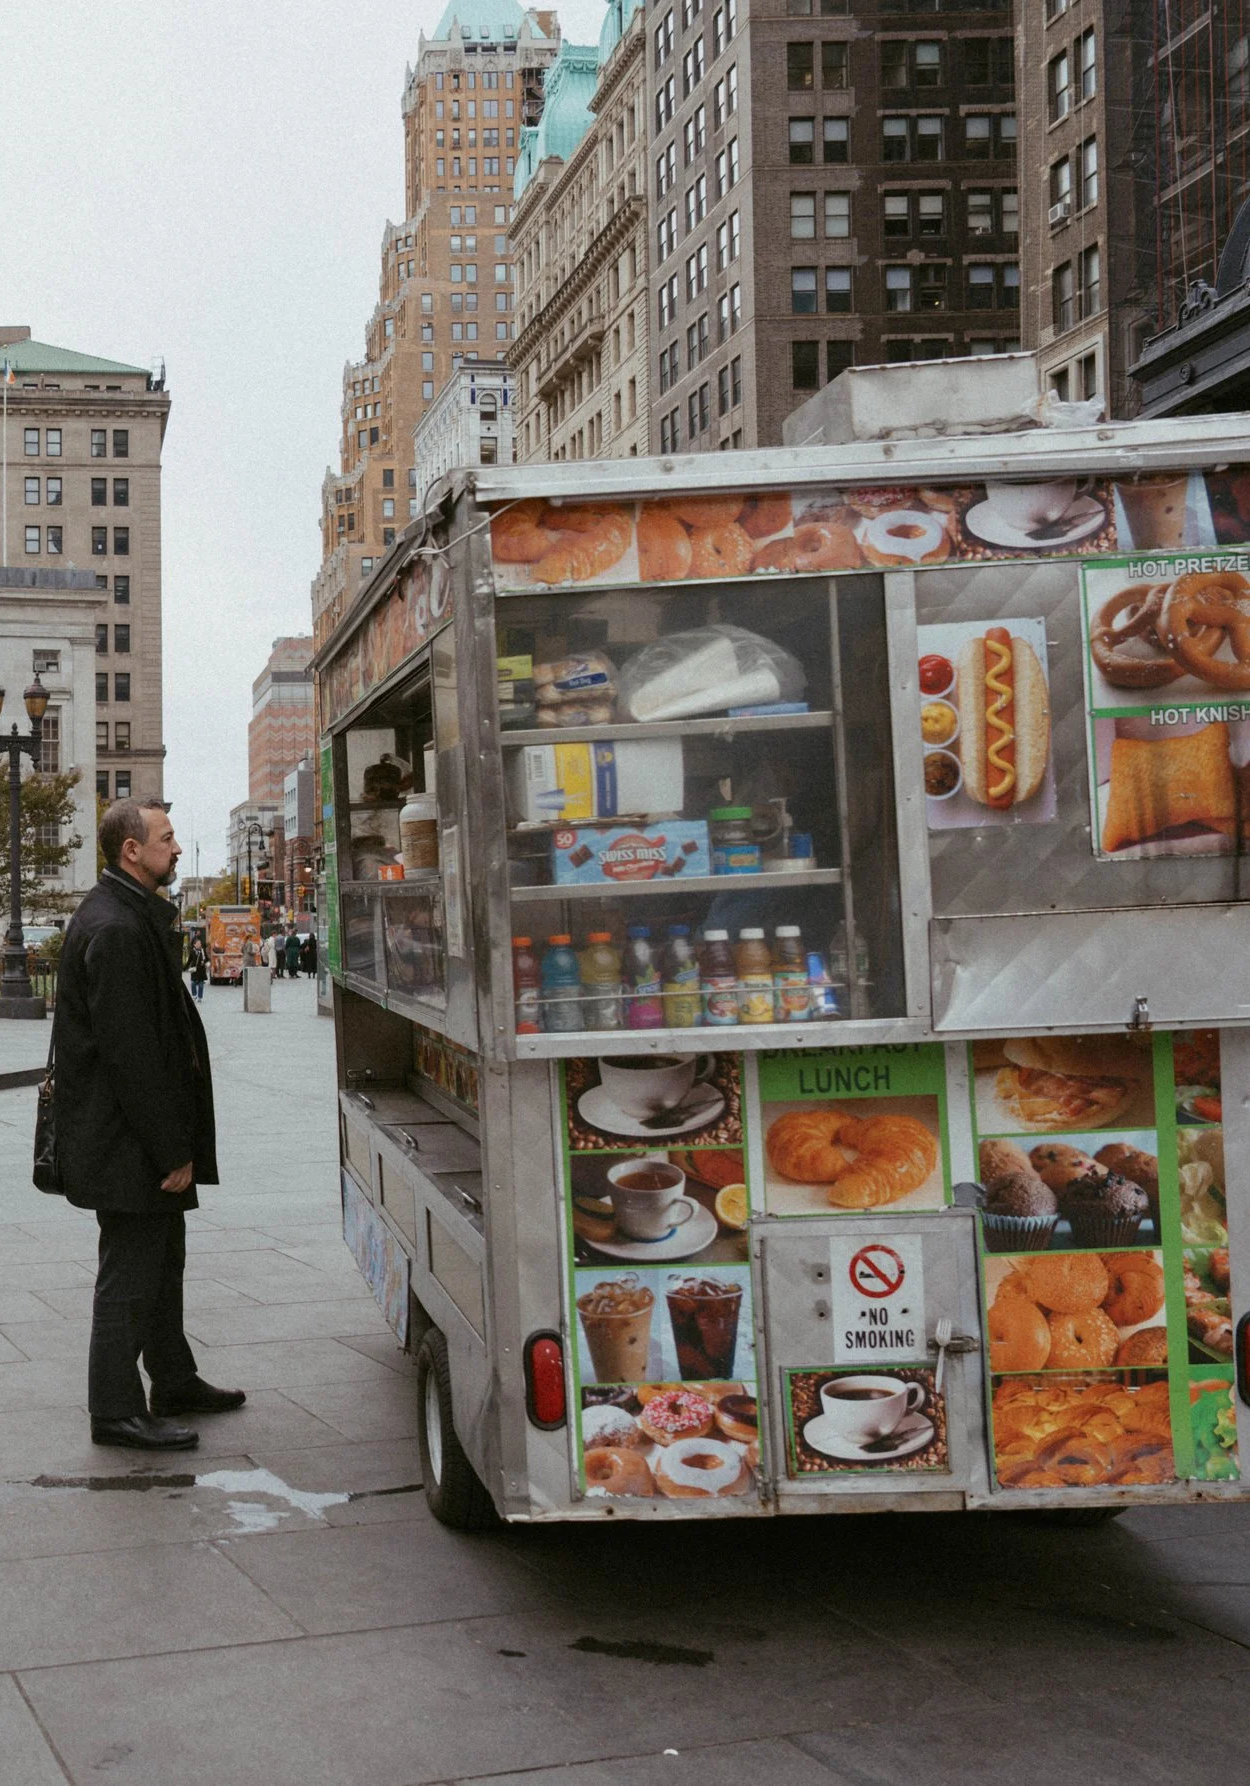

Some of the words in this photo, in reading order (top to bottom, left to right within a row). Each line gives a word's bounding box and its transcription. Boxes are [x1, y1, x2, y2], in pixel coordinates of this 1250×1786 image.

[1129, 560, 1169, 577] HOT
[1151, 708, 1191, 725] HOT
[556, 832, 573, 845] 50
[800, 1065, 891, 1094] LUNCH
[868, 1307, 889, 1326] NO
[845, 1329, 915, 1349] SMOKING
